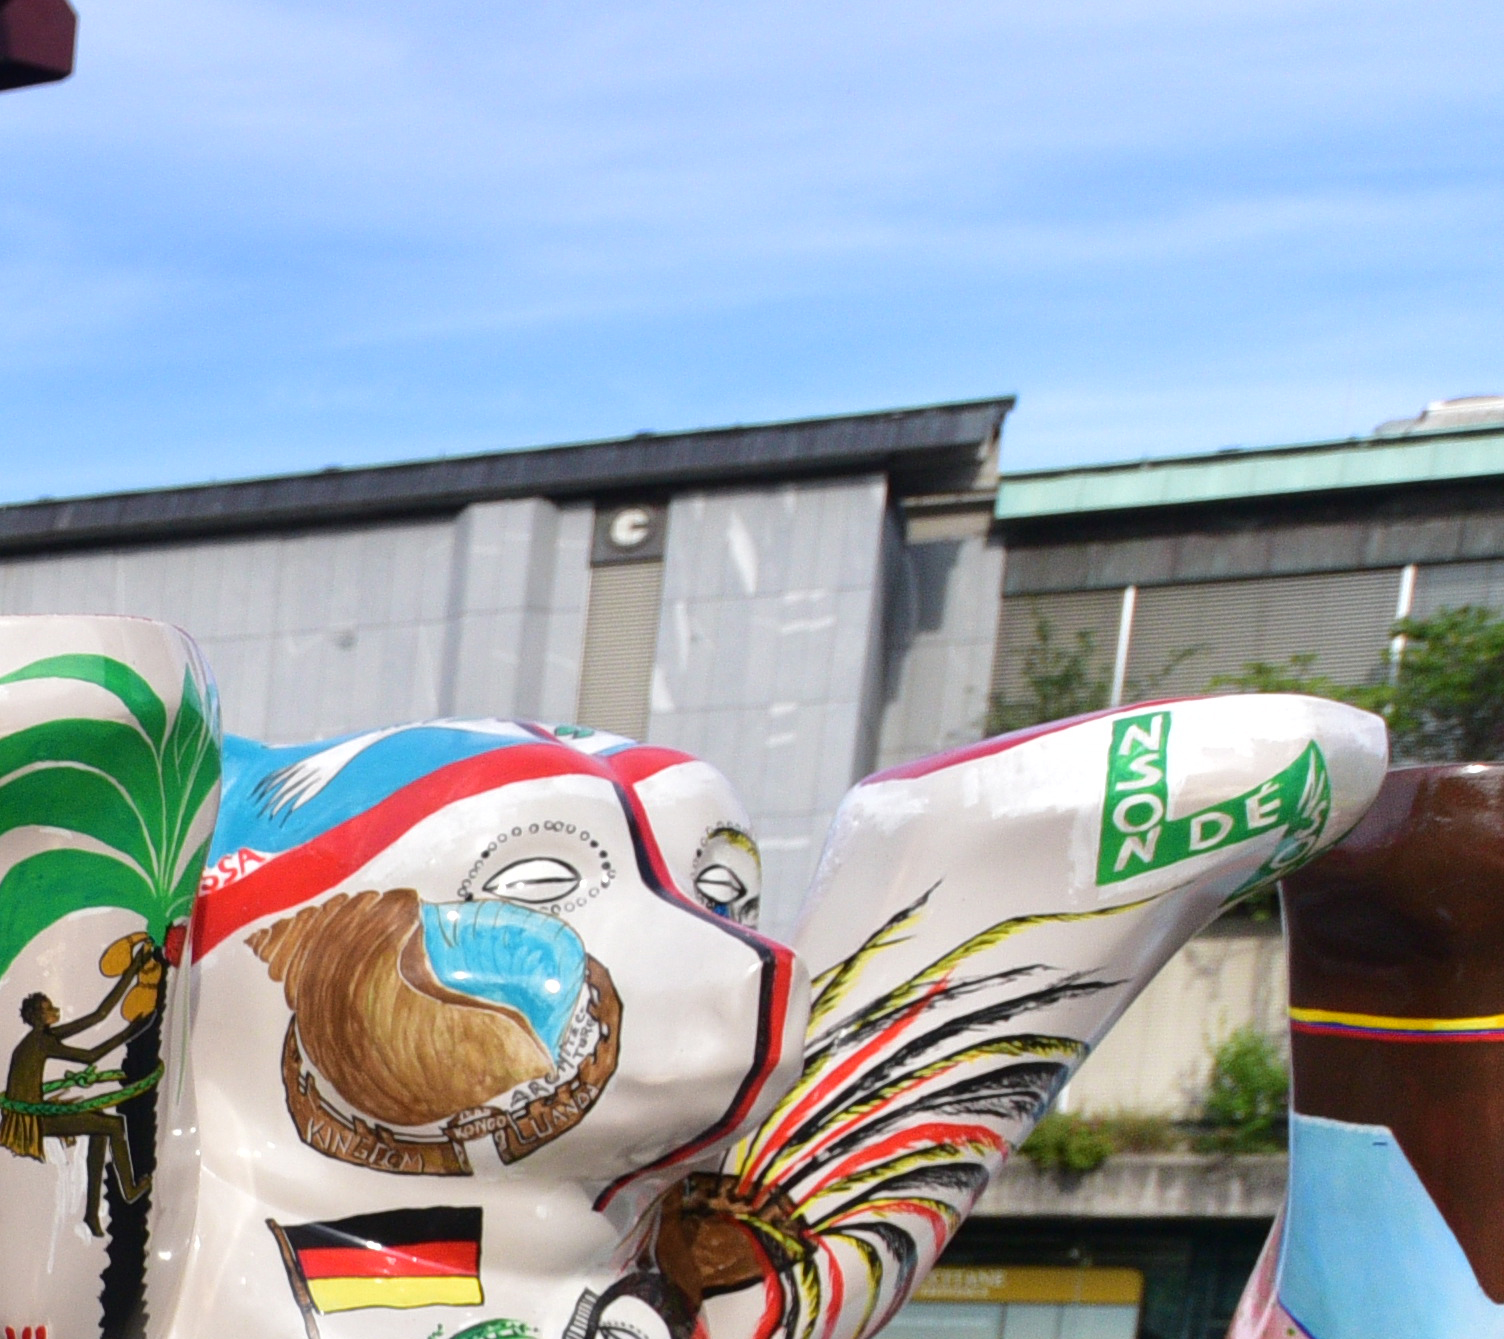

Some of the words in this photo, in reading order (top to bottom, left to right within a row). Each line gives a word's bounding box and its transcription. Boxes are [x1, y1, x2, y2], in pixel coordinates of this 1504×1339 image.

[453, 1114, 507, 1139] KONGO
[506, 1084, 600, 1144] LUANDA
[307, 1117, 424, 1172] KINGDOM
